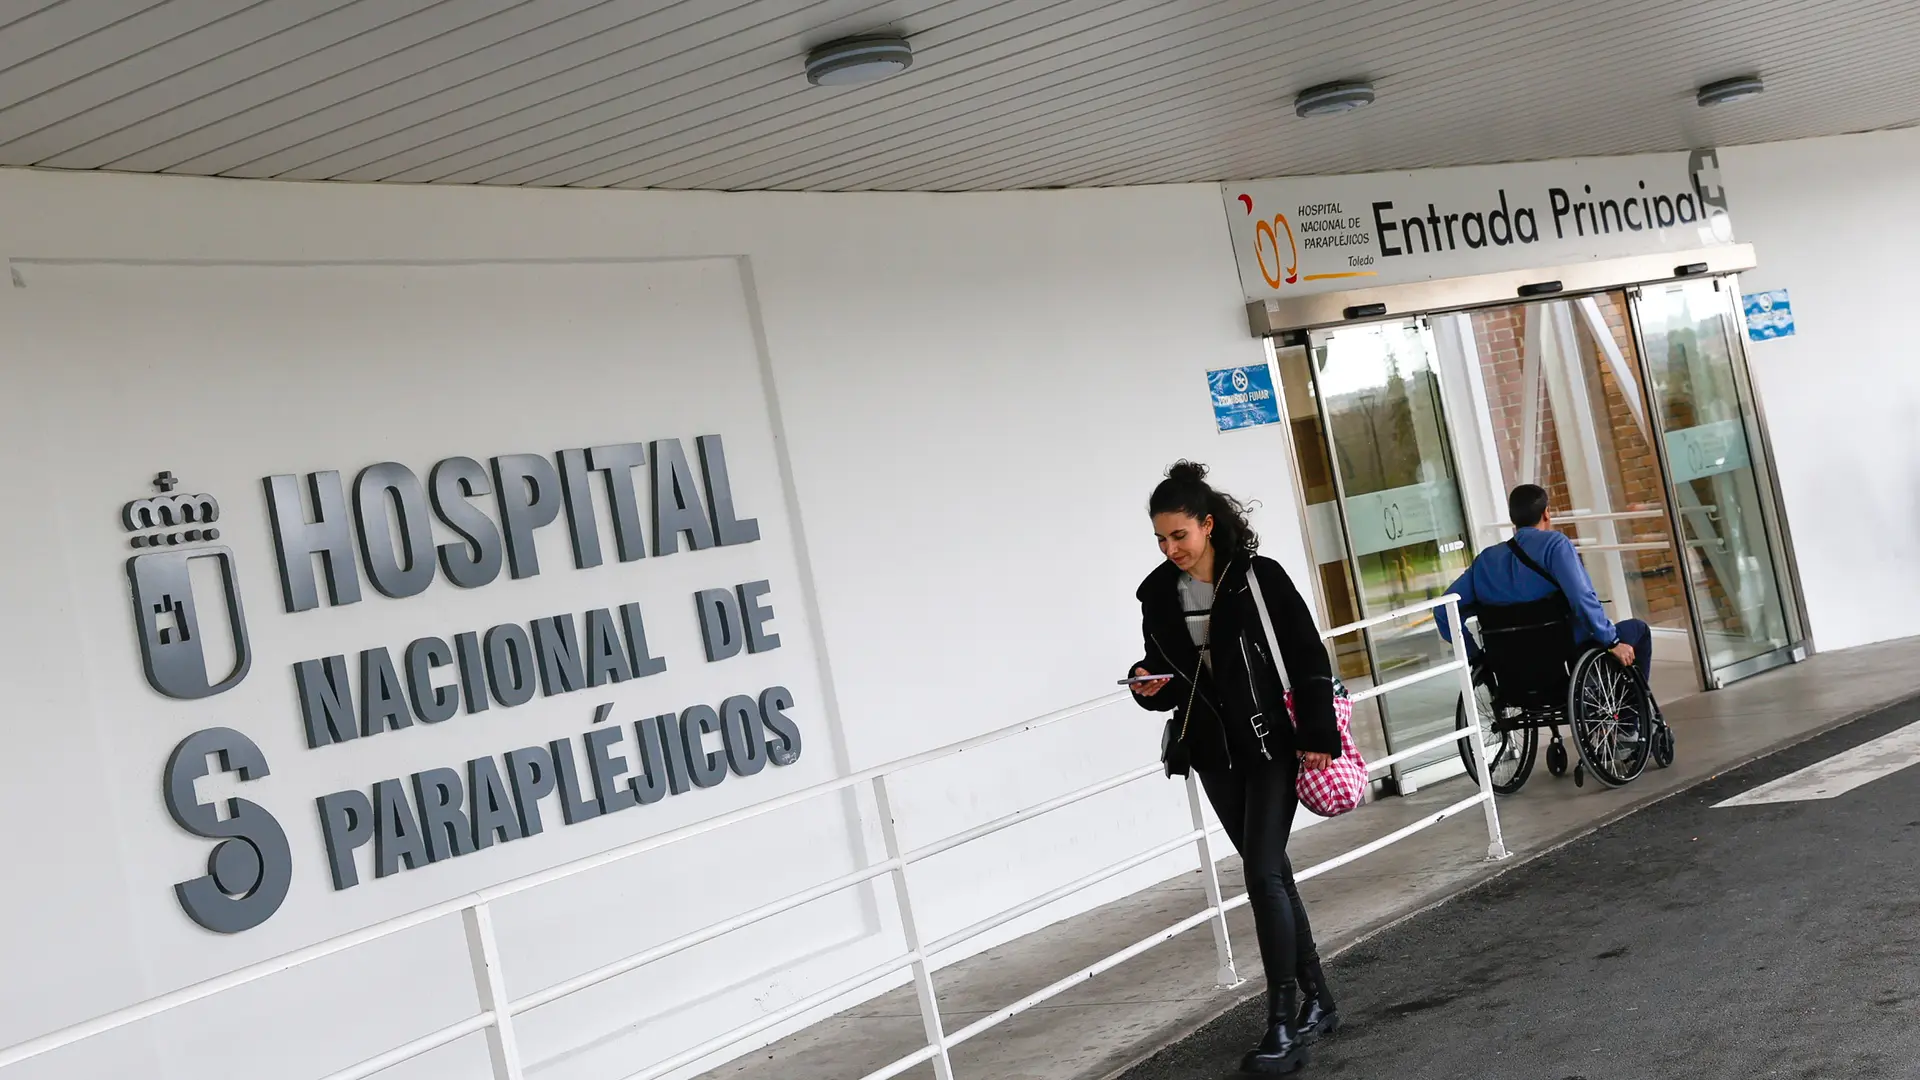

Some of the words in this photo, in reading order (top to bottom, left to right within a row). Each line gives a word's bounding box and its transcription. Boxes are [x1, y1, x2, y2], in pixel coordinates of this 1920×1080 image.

[1298, 203, 1342, 216] HOSPITAL
[1300, 218, 1346, 233] NACIONAL
[1348, 217, 1361, 228] DE
[1371, 189, 1540, 258] Entrada
[1548, 173, 1707, 241] Principal
[1304, 231, 1370, 249] PARAPLÉJICOS
[1348, 254, 1374, 267] Toledo
[262, 434, 760, 613] HOSPITAL
[293, 601, 667, 749] NACIONAL
[694, 579, 782, 662] DE
[316, 686, 802, 891] PARAPLÉJICOS
